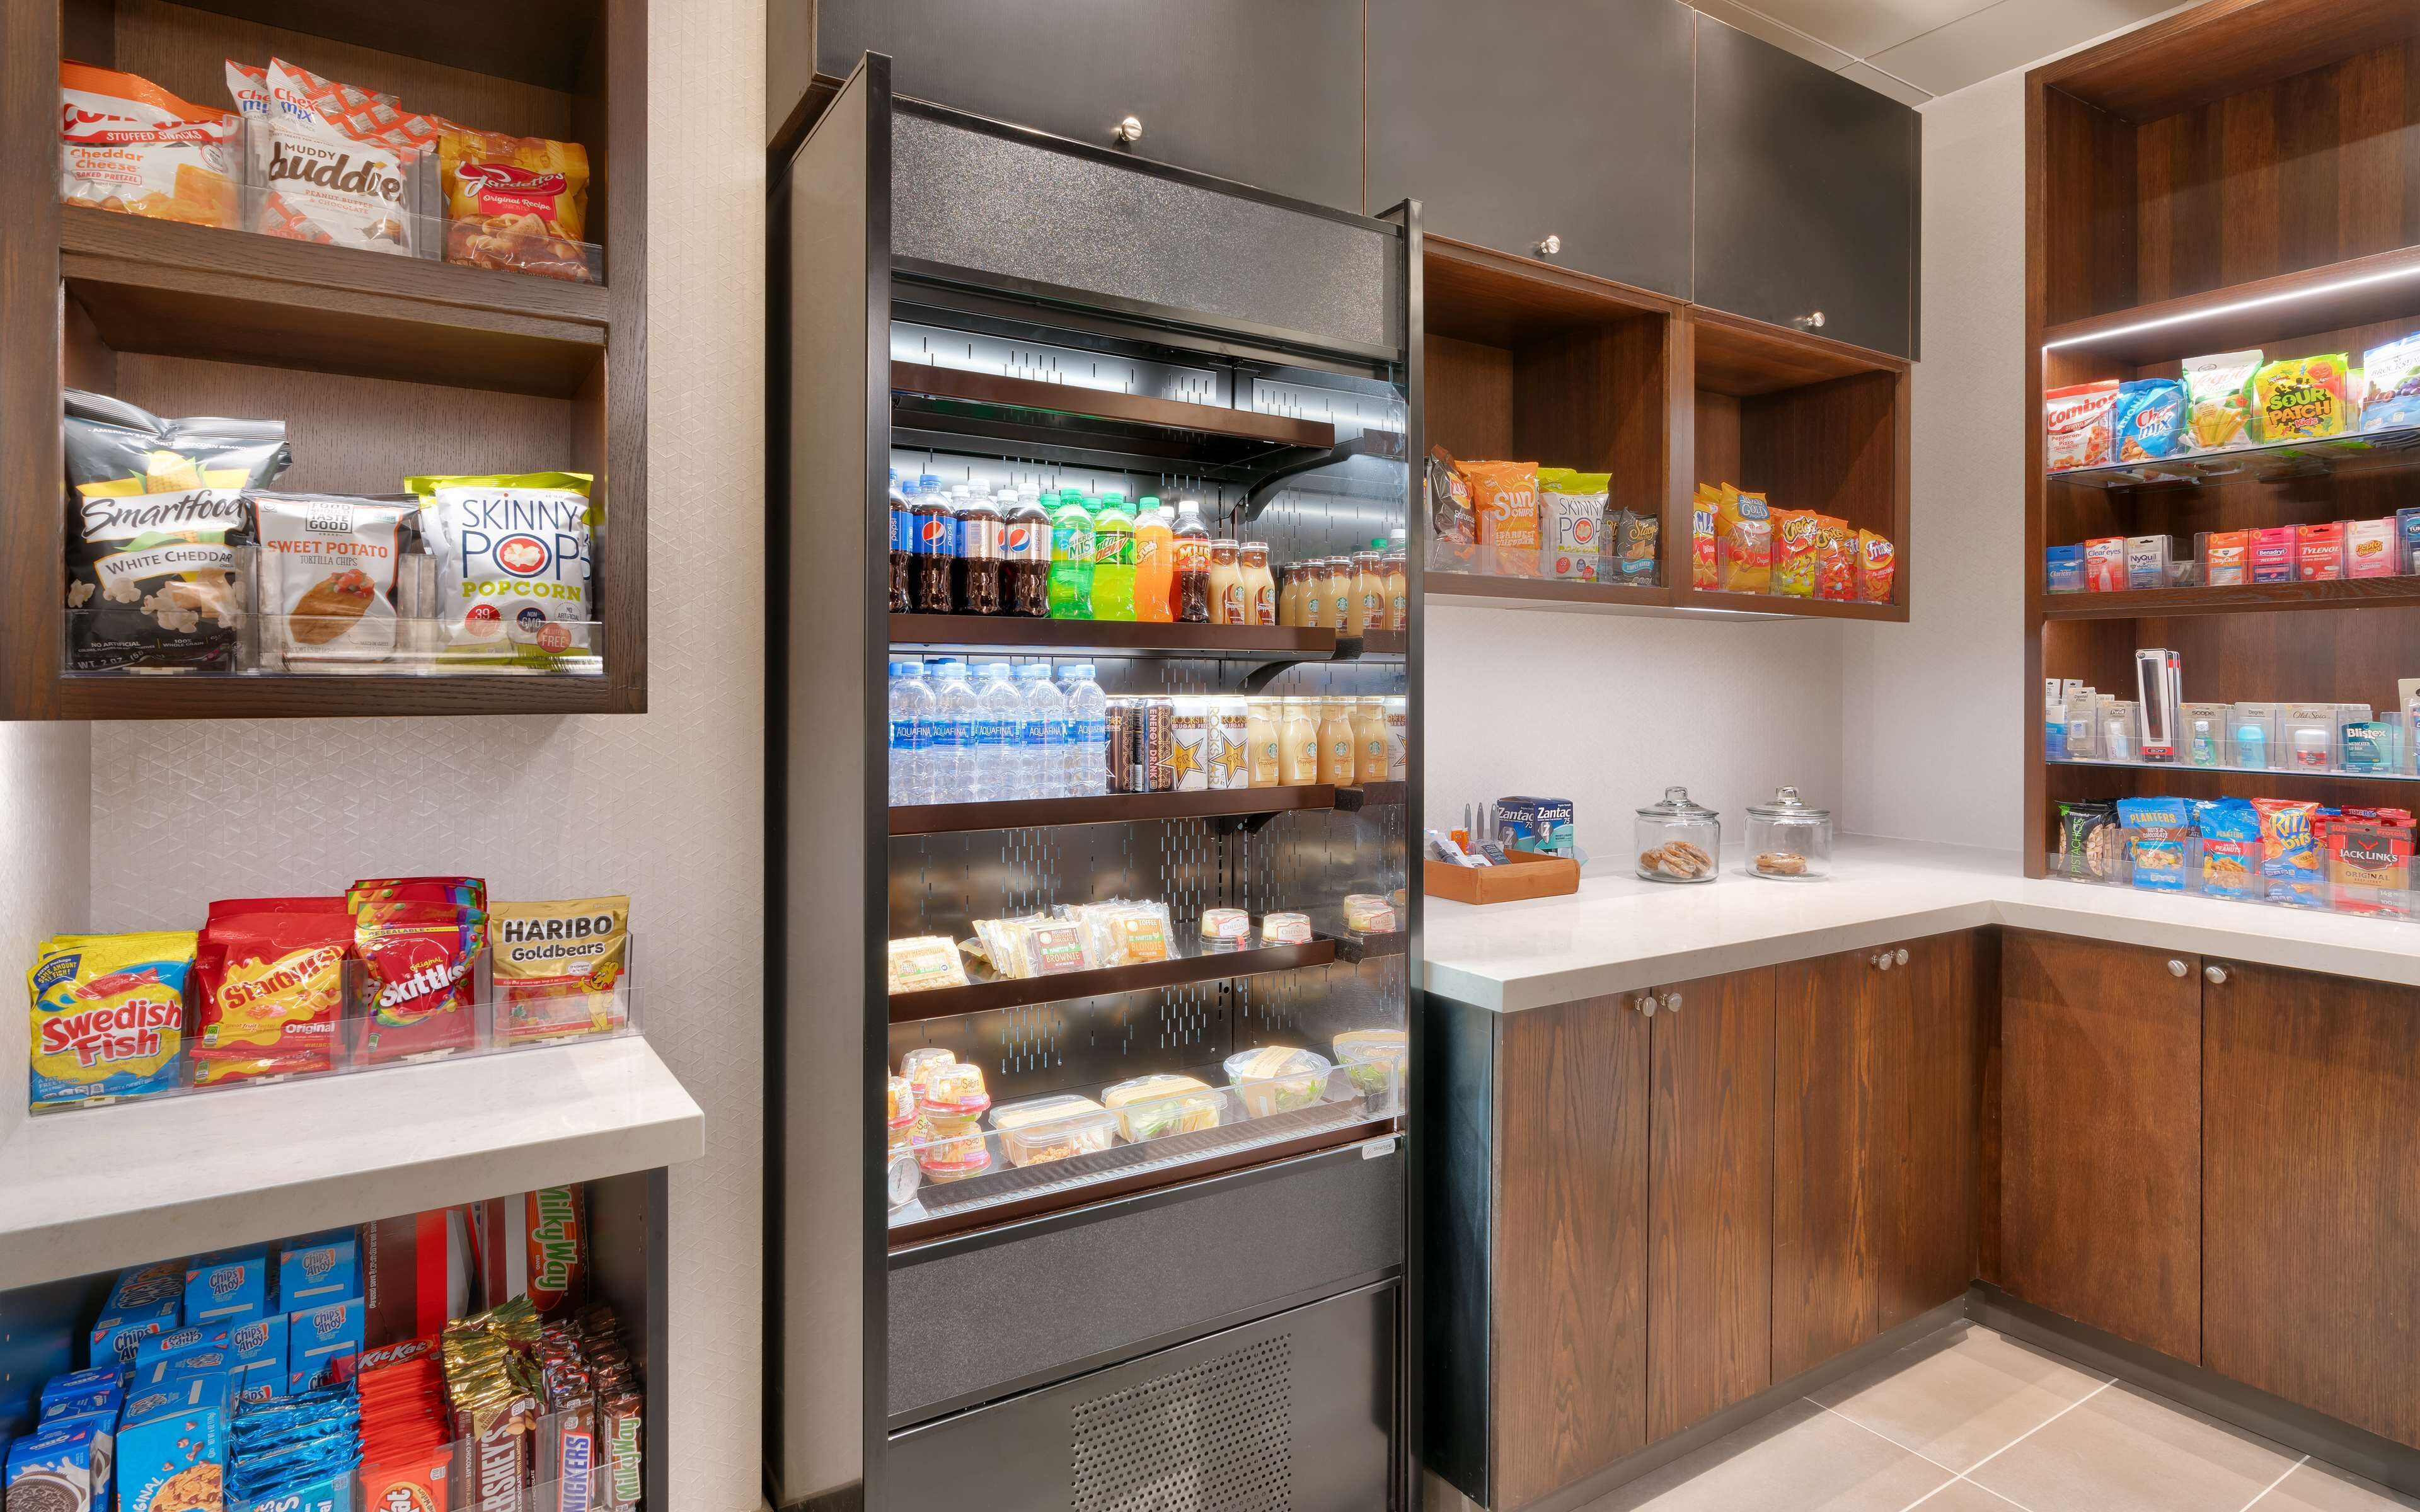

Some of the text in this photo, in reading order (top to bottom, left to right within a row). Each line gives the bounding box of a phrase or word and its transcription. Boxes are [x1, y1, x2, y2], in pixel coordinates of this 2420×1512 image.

[237, 89, 270, 101] Che
[274, 88, 318, 110] Chex
[243, 100, 268, 113] mi
[281, 101, 315, 123] mix
[107, 130, 202, 141] STUFFED SNACKS
[70, 149, 144, 162] Cheddar
[284, 142, 336, 160] MUDDY
[75, 159, 137, 172] Cheese
[268, 141, 406, 204] buddie
[105, 172, 137, 183] PRETZEL
[306, 190, 374, 209] PEANUT BUTTER
[318, 199, 369, 214] CHOCOLATE
[483, 195, 520, 205] Original
[522, 198, 551, 210] Recipe
[2270, 387, 2326, 410] SOUR
[2048, 392, 2118, 427] Combos
[2268, 399, 2331, 425] PATCH
[2138, 419, 2173, 440] mix
[2294, 417, 2319, 428] Kids
[2051, 433, 2082, 442] Pepperoni
[463, 493, 578, 532] SKINNY
[1494, 491, 1535, 521] Sun
[1512, 508, 1534, 517] CHIPS
[1559, 497, 1606, 516] SKINNY
[1741, 503, 1768, 519] GOLD
[81, 490, 244, 539] Smartfood
[309, 520, 349, 531] GOOD
[1559, 517, 1600, 544] POP
[1630, 520, 1658, 540] Stacy's
[1068, 531, 1093, 547] SIERR
[267, 541, 388, 558] SWEET POTATO
[462, 530, 580, 581] POP
[1068, 537, 1095, 559] MIST
[1178, 544, 1211, 559] MUG
[2302, 546, 2340, 555] TYLENOL
[2359, 545, 2383, 555] Bismol
[105, 550, 233, 575] WHITE CHEDDAR
[299, 555, 358, 566] TORTILLA CHIPS
[1756, 556, 1770, 565] Original
[2130, 554, 2157, 563] NyQuil
[2211, 556, 2239, 565] DayQuil
[462, 581, 582, 602] POPCORN
[475, 608, 490, 619] 39
[521, 617, 541, 627] GMO
[542, 635, 566, 648] FREE
[2293, 711, 2309, 719] Old
[897, 726, 932, 737] AQUAFINA
[934, 726, 969, 737] AQUAFINA
[979, 726, 1013, 736] AQUAFINA
[1029, 726, 1062, 736] AQUAFINA
[1078, 724, 1105, 735] AQUAFIN
[2346, 727, 2387, 740] Blistex
[1149, 709, 1158, 779] ENERGY DRINK
[1498, 807, 1533, 822] Zantac
[1537, 806, 1571, 819] Zantac
[2130, 812, 2177, 823] PLANTERS
[1525, 821, 1533, 829] 75
[2270, 813, 2310, 837] RITZ
[2331, 825, 2347, 833] 100
[2071, 816, 2085, 874] PISTACHIOS
[2281, 832, 2312, 850] bits
[2339, 849, 2399, 862] JACK LINK'S
[2345, 870, 2391, 881] ORIGINAL
[2379, 890, 2392, 898] 14g
[505, 915, 613, 943] HARIBO
[512, 942, 604, 961] Goldbears
[1131, 941, 1162, 951] BLONDIE
[1046, 953, 1080, 963] BROWNIE
[37, 965, 50, 976] NEW
[52, 969, 70, 978] FISH!
[53, 962, 77, 973] AMOUNT
[222, 945, 342, 1009] Starburst
[43, 1000, 182, 1053] Swedish
[285, 1021, 335, 1033] Original
[71, 1028, 161, 1065] Fish
[962, 1077, 980, 1089] Sabra
[916, 1120, 931, 1131] Sab
[302, 1250, 329, 1269] Chips
[307, 1252, 335, 1276] Ahoy!
[209, 1269, 237, 1288] Chips
[213, 1271, 245, 1296] Ahoy!
[314, 1309, 340, 1327] Chips
[318, 1312, 346, 1334] Ahoy!
[234, 1326, 262, 1345] Chips
[238, 1329, 268, 1352] Ahoy!
[357, 1341, 427, 1370] KitKat
